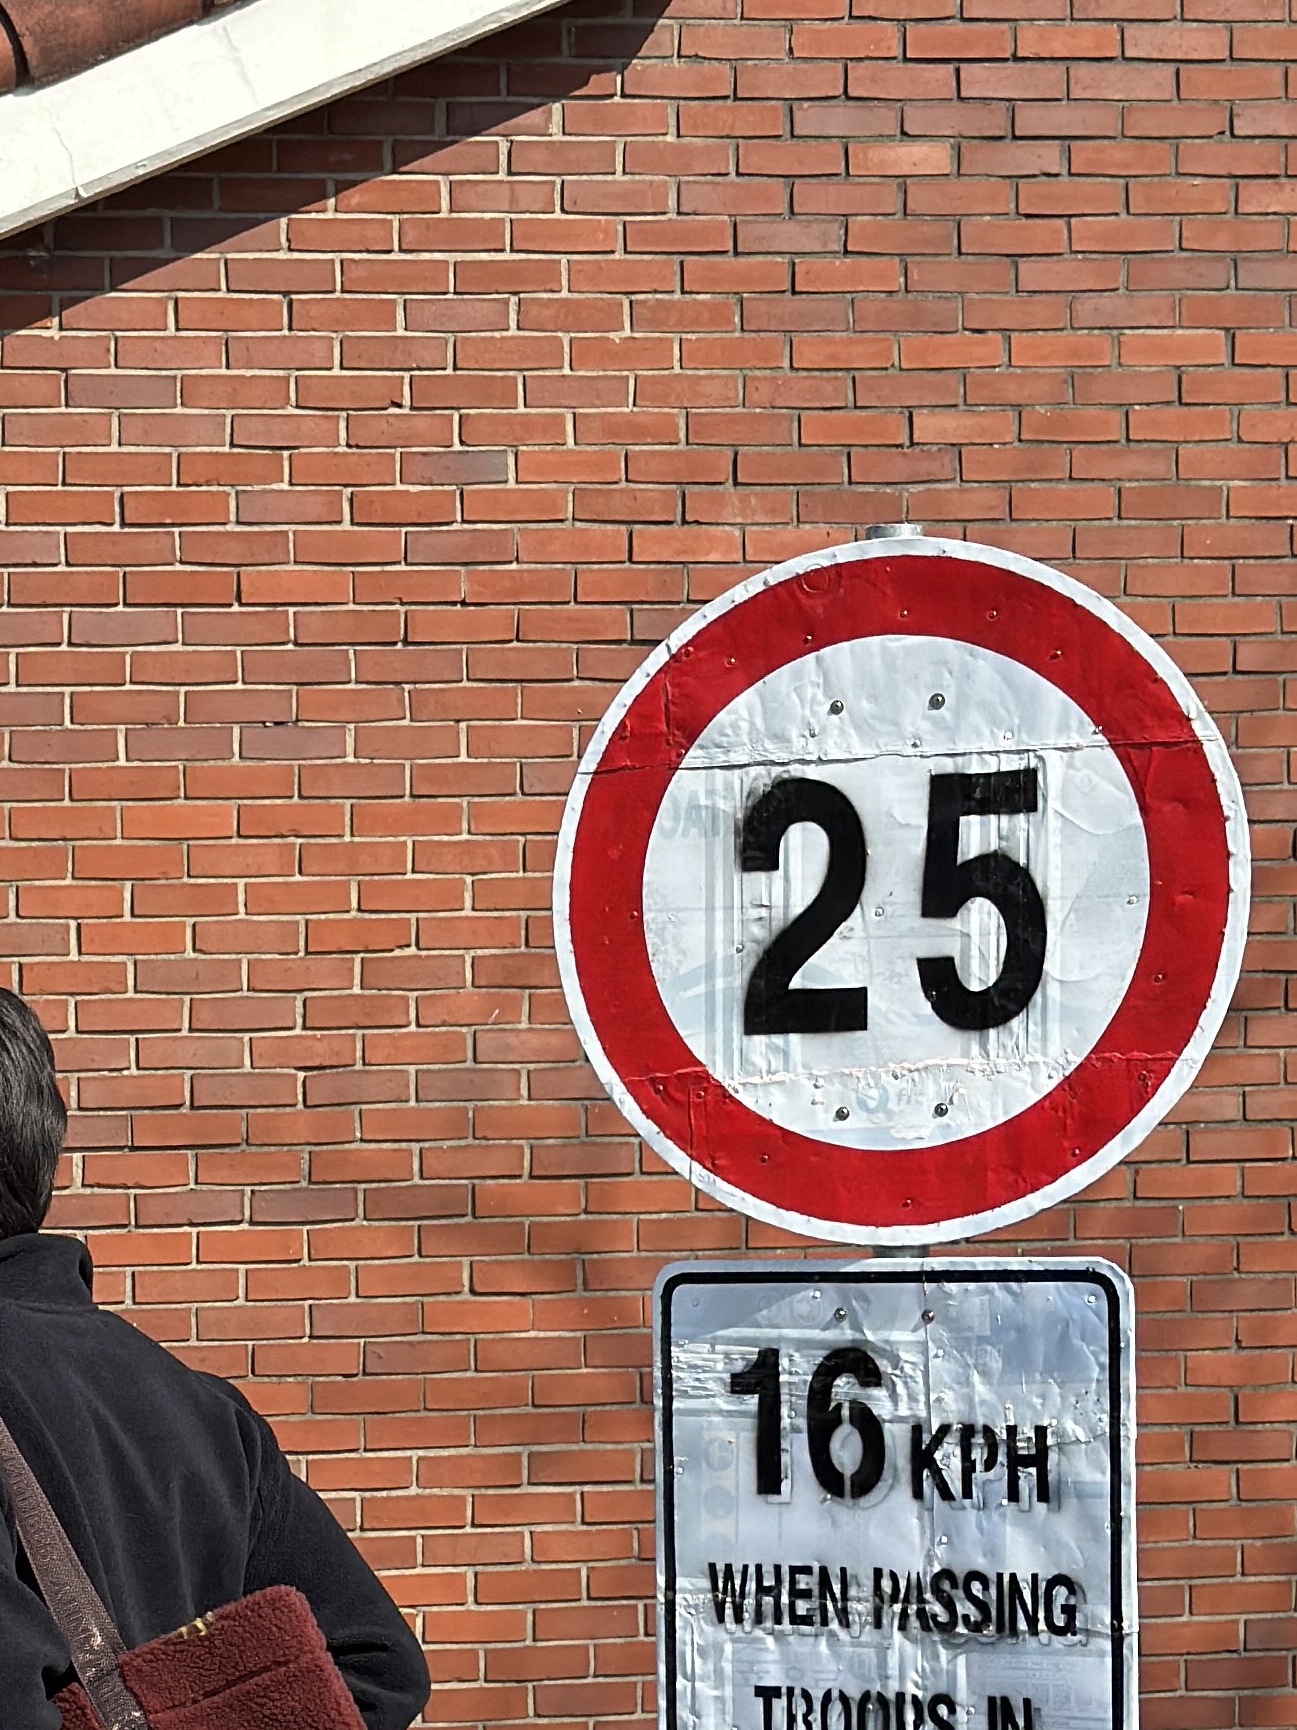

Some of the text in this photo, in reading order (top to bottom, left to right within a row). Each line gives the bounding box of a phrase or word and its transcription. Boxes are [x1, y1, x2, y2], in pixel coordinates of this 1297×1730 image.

[738, 767, 1048, 1036] 25
[730, 1346, 1050, 1504] 16 KPH
[708, 1562, 1079, 1638] WHEN PASSING
